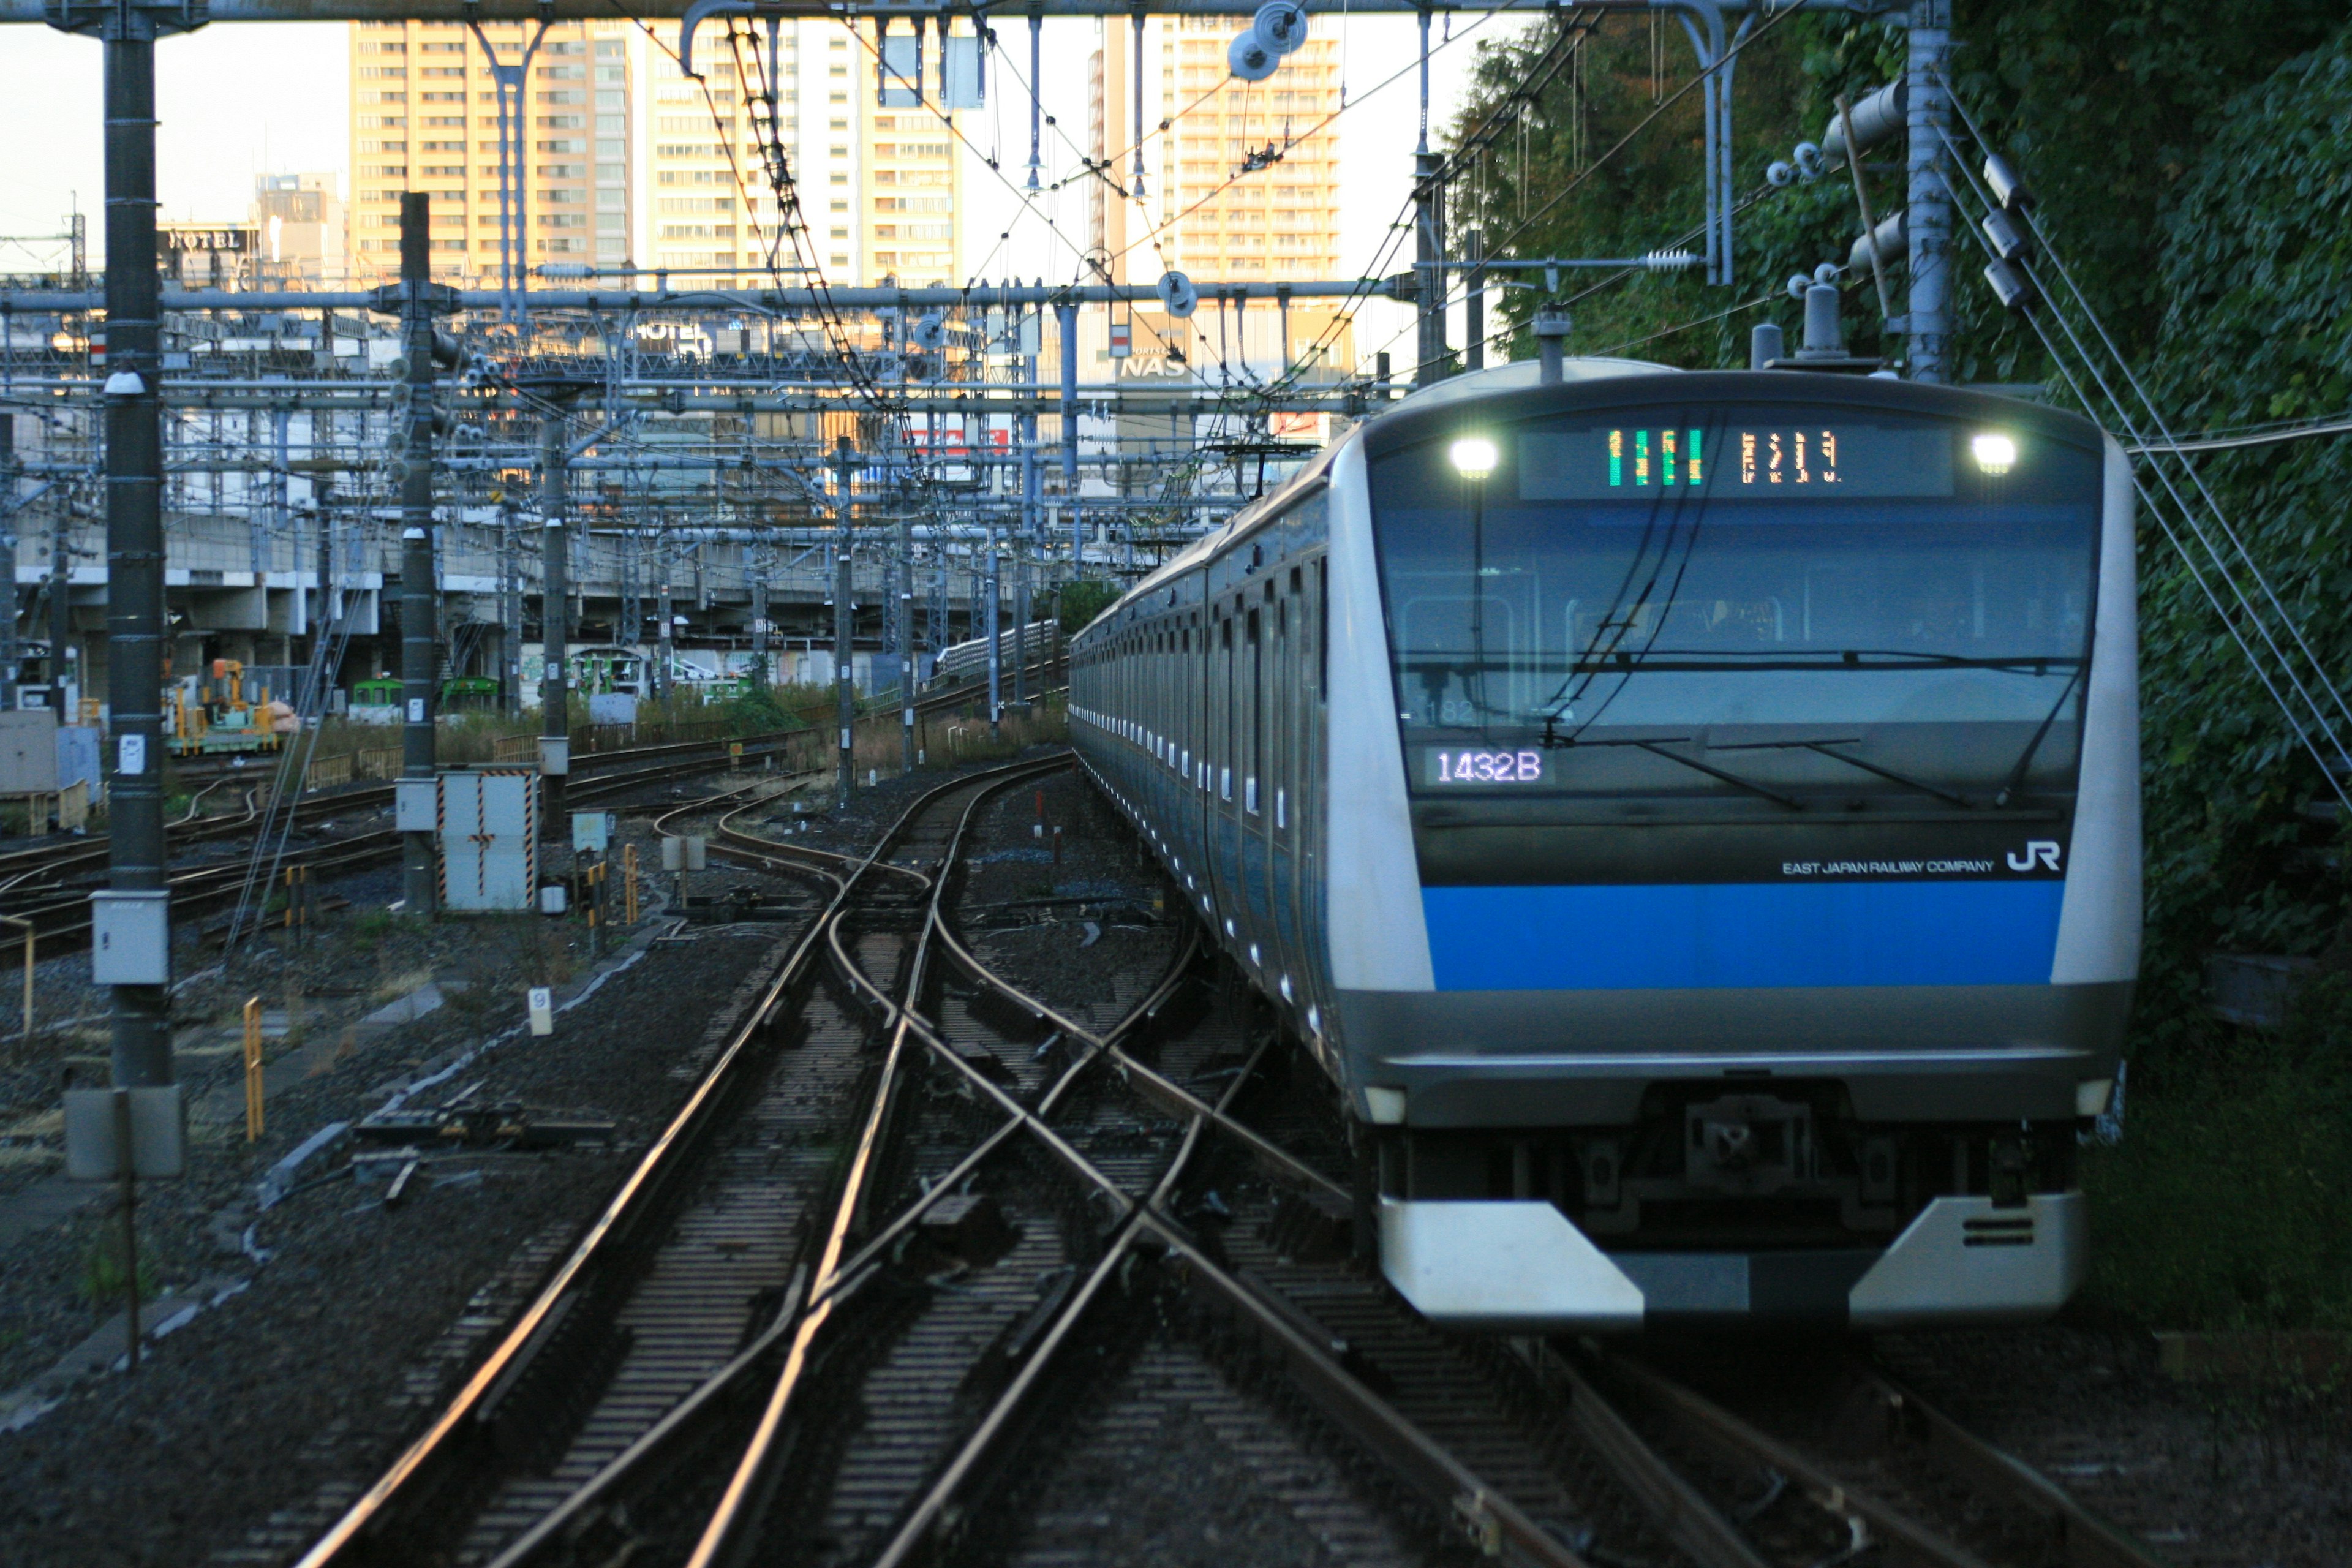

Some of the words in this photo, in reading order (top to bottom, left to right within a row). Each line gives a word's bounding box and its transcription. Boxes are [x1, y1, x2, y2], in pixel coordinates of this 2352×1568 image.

[168, 231, 239, 249] HOTEL
[1120, 357, 1185, 377] NAS
[1439, 752, 1541, 781] 1432B
[2007, 841, 2061, 871] JR
[1782, 862, 1821, 874] EAST
[1822, 862, 1868, 874] JAPAN
[1869, 861, 1924, 873] RAILWAY
[1926, 860, 1994, 873] COMPANY
[534, 993, 545, 1008] 9
